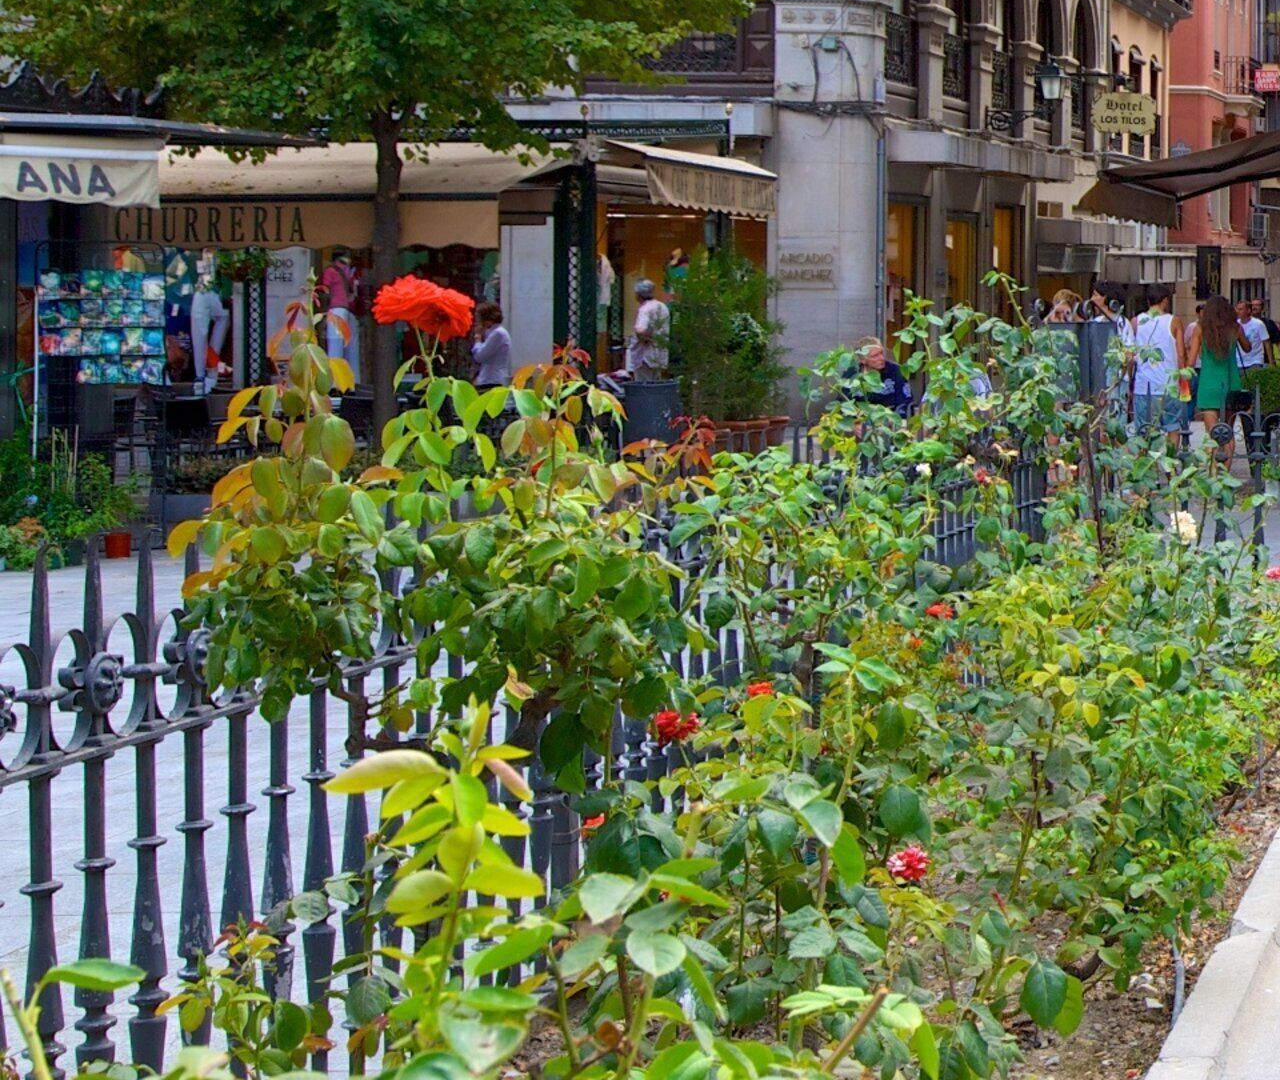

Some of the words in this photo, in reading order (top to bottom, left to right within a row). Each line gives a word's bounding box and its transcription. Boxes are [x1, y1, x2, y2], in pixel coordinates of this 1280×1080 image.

[1106, 99, 1143, 112] Hotel
[1101, 116, 1118, 125] LOS
[1121, 116, 1147, 126] TILOS
[16, 161, 117, 198] ANA
[115, 206, 307, 243] CHURRERIA
[780, 253, 833, 265] ARCADIO
